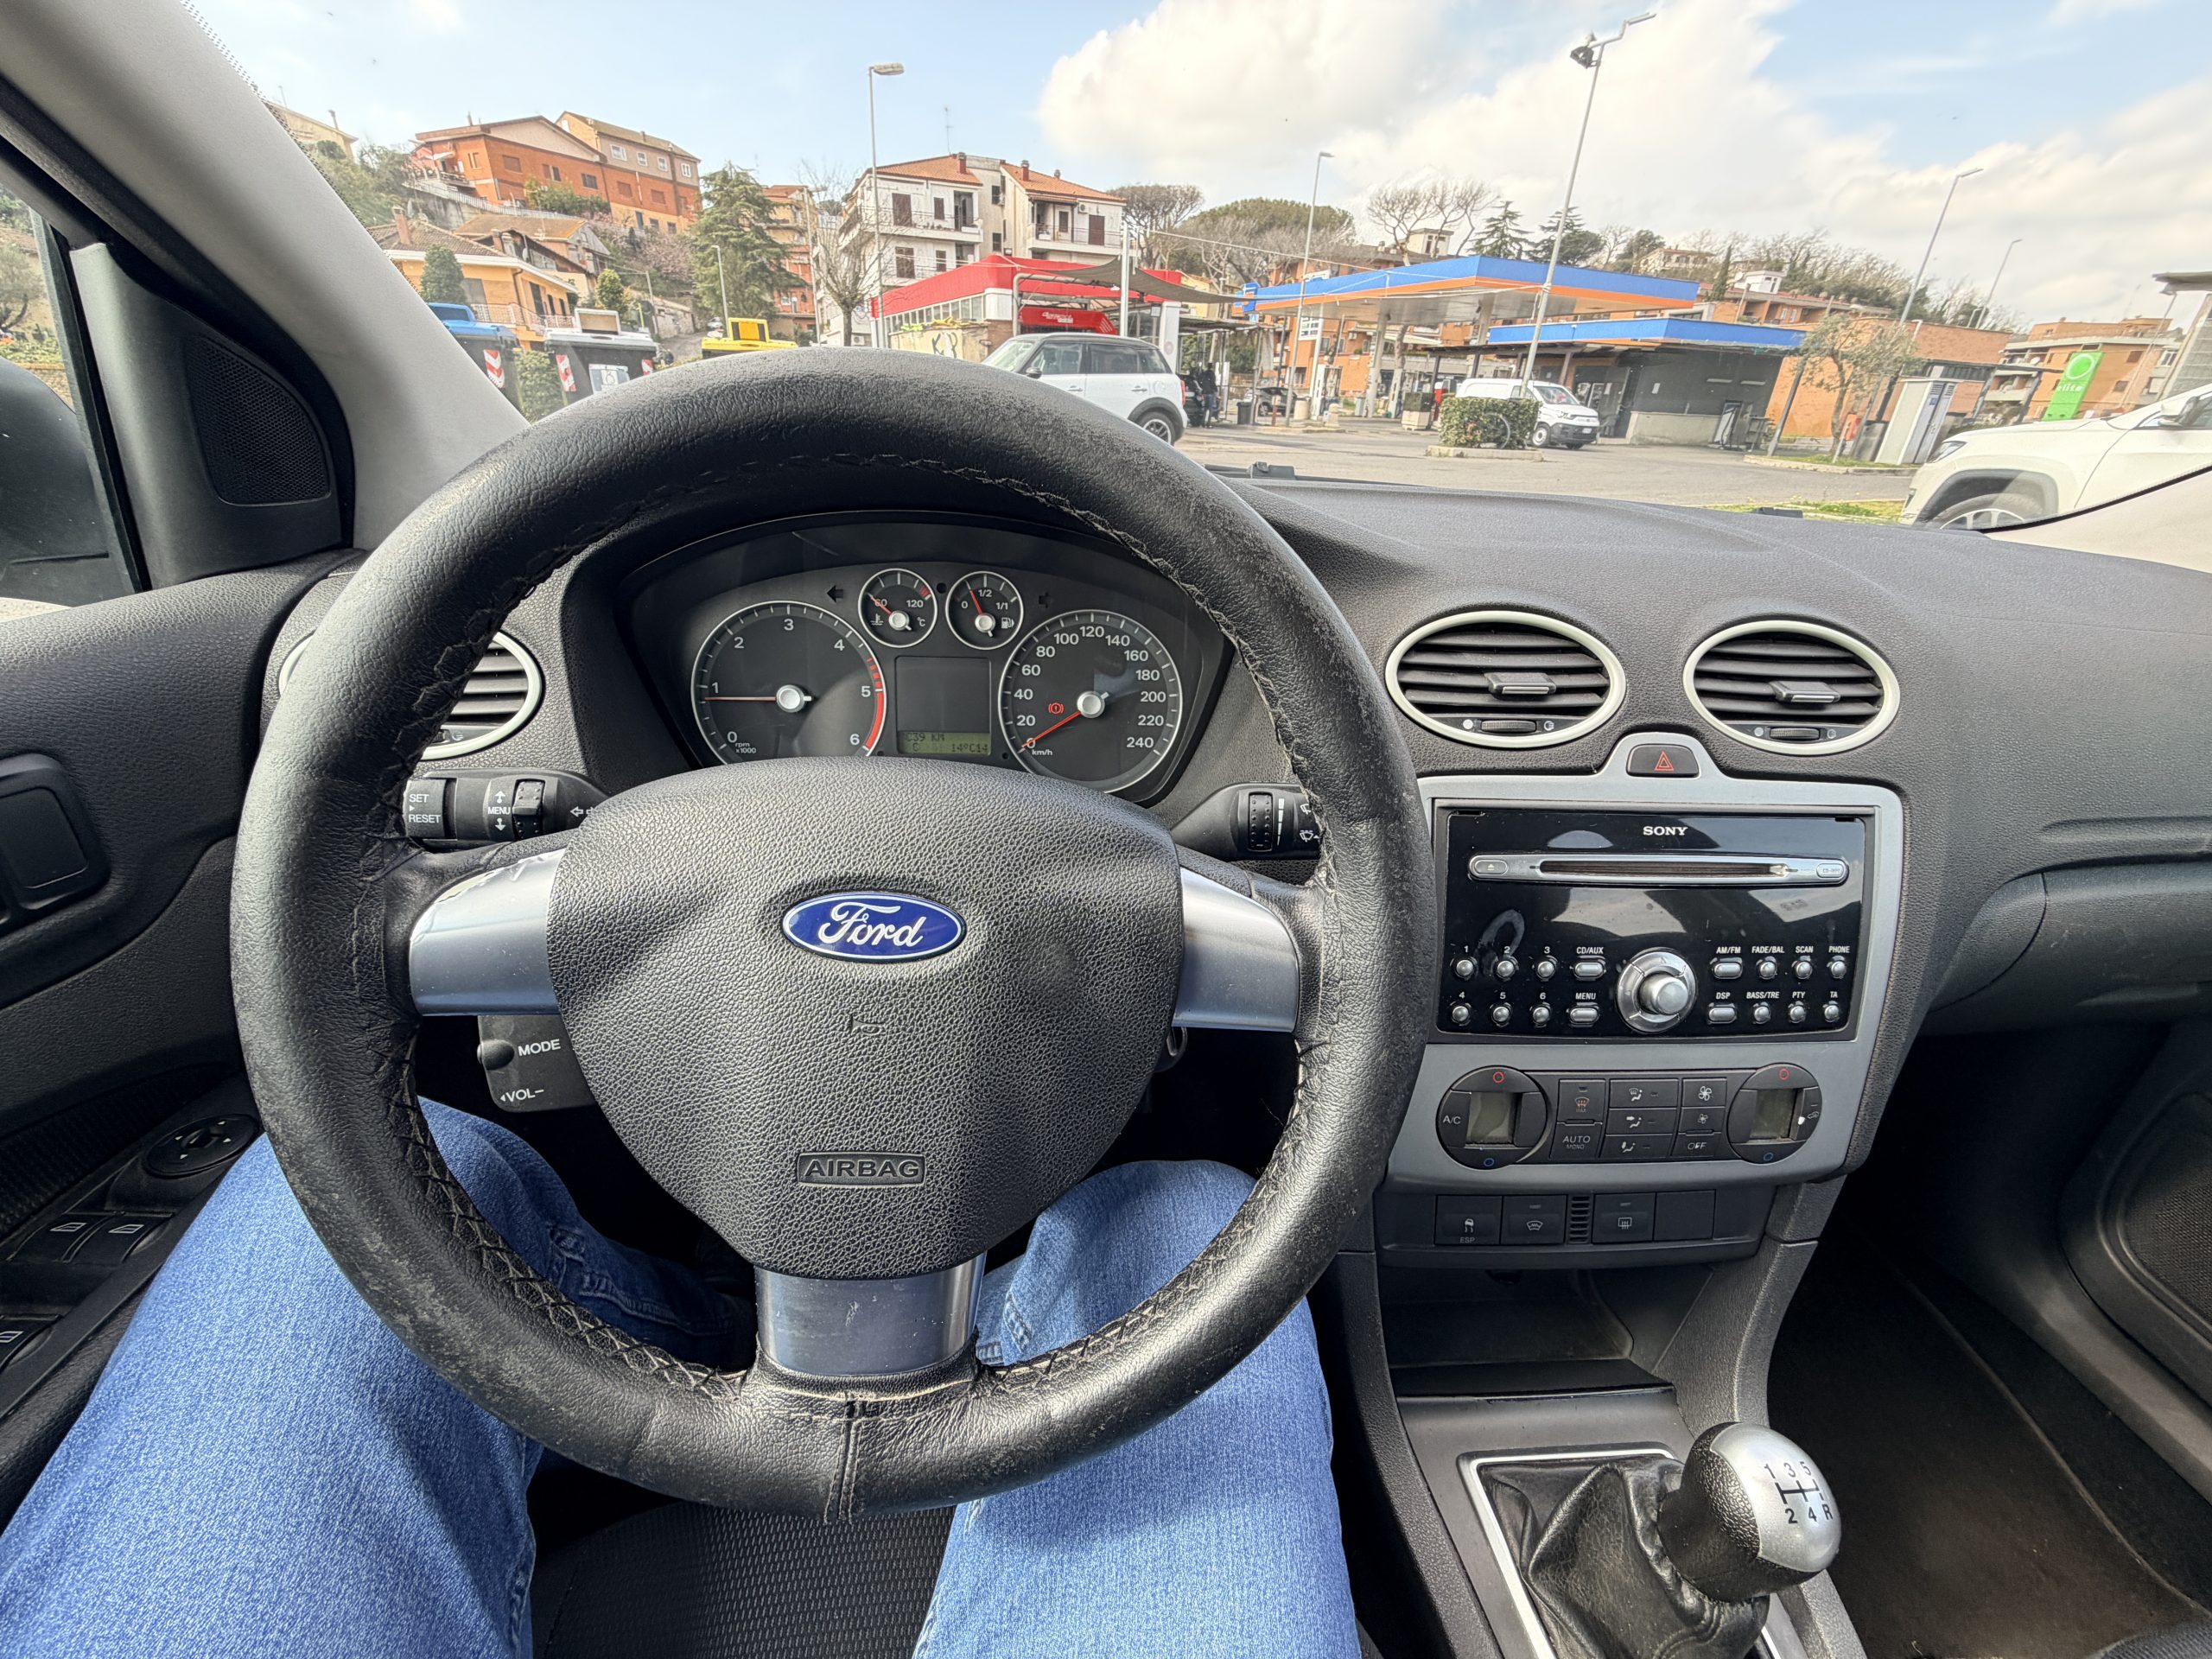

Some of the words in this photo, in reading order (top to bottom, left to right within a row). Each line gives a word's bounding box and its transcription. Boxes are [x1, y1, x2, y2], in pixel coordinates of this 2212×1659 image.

[906, 600, 924, 608] 120
[961, 601, 968, 609] 0
[784, 620, 794, 631] 3
[1080, 626, 1104, 638] 120
[734, 638, 744, 648] 2
[1054, 633, 1079, 645] 100
[1105, 635, 1130, 646] 140
[834, 639, 845, 651] 4
[1036, 645, 1056, 658] 80
[1124, 650, 1149, 662] 160
[1021, 664, 1040, 677] 60
[1135, 670, 1160, 681] 180
[711, 683, 719, 693] 1
[861, 686, 871, 697] 5
[1014, 689, 1033, 700] 40
[1140, 691, 1166, 702] 200
[1016, 715, 1035, 727] 20
[1137, 715, 1164, 727] 220
[727, 732, 737, 743] 0
[849, 734, 860, 745] 6
[1126, 737, 1154, 748] 240
[1027, 738, 1036, 749] 0
[409, 794, 429, 804] SET
[488, 806, 512, 815] MENU
[409, 814, 441, 823] RESET
[1643, 826, 1688, 836] SONY
[817, 901, 927, 947] Ford
[1504, 945, 1510, 954] 2
[1576, 946, 1604, 955] CD/AUX
[1796, 945, 1814, 954] SCAN
[1828, 945, 1850, 954] PHONE
[1575, 992, 1597, 1001] MENU
[1716, 991, 1731, 1000] DSP
[518, 1039, 561, 1056] MODE
[1443, 1116, 1461, 1124] A/C
[1688, 1141, 1707, 1150] OFF
[804, 1160, 919, 1178] AIRBAG
[1764, 1463, 1776, 1479] 1
[1783, 1462, 1796, 1478] 3
[1799, 1461, 1812, 1476] 5
[1784, 1508, 1798, 1524] 2
[1808, 1507, 1817, 1522] 4
[1821, 1503, 1834, 1520] R
